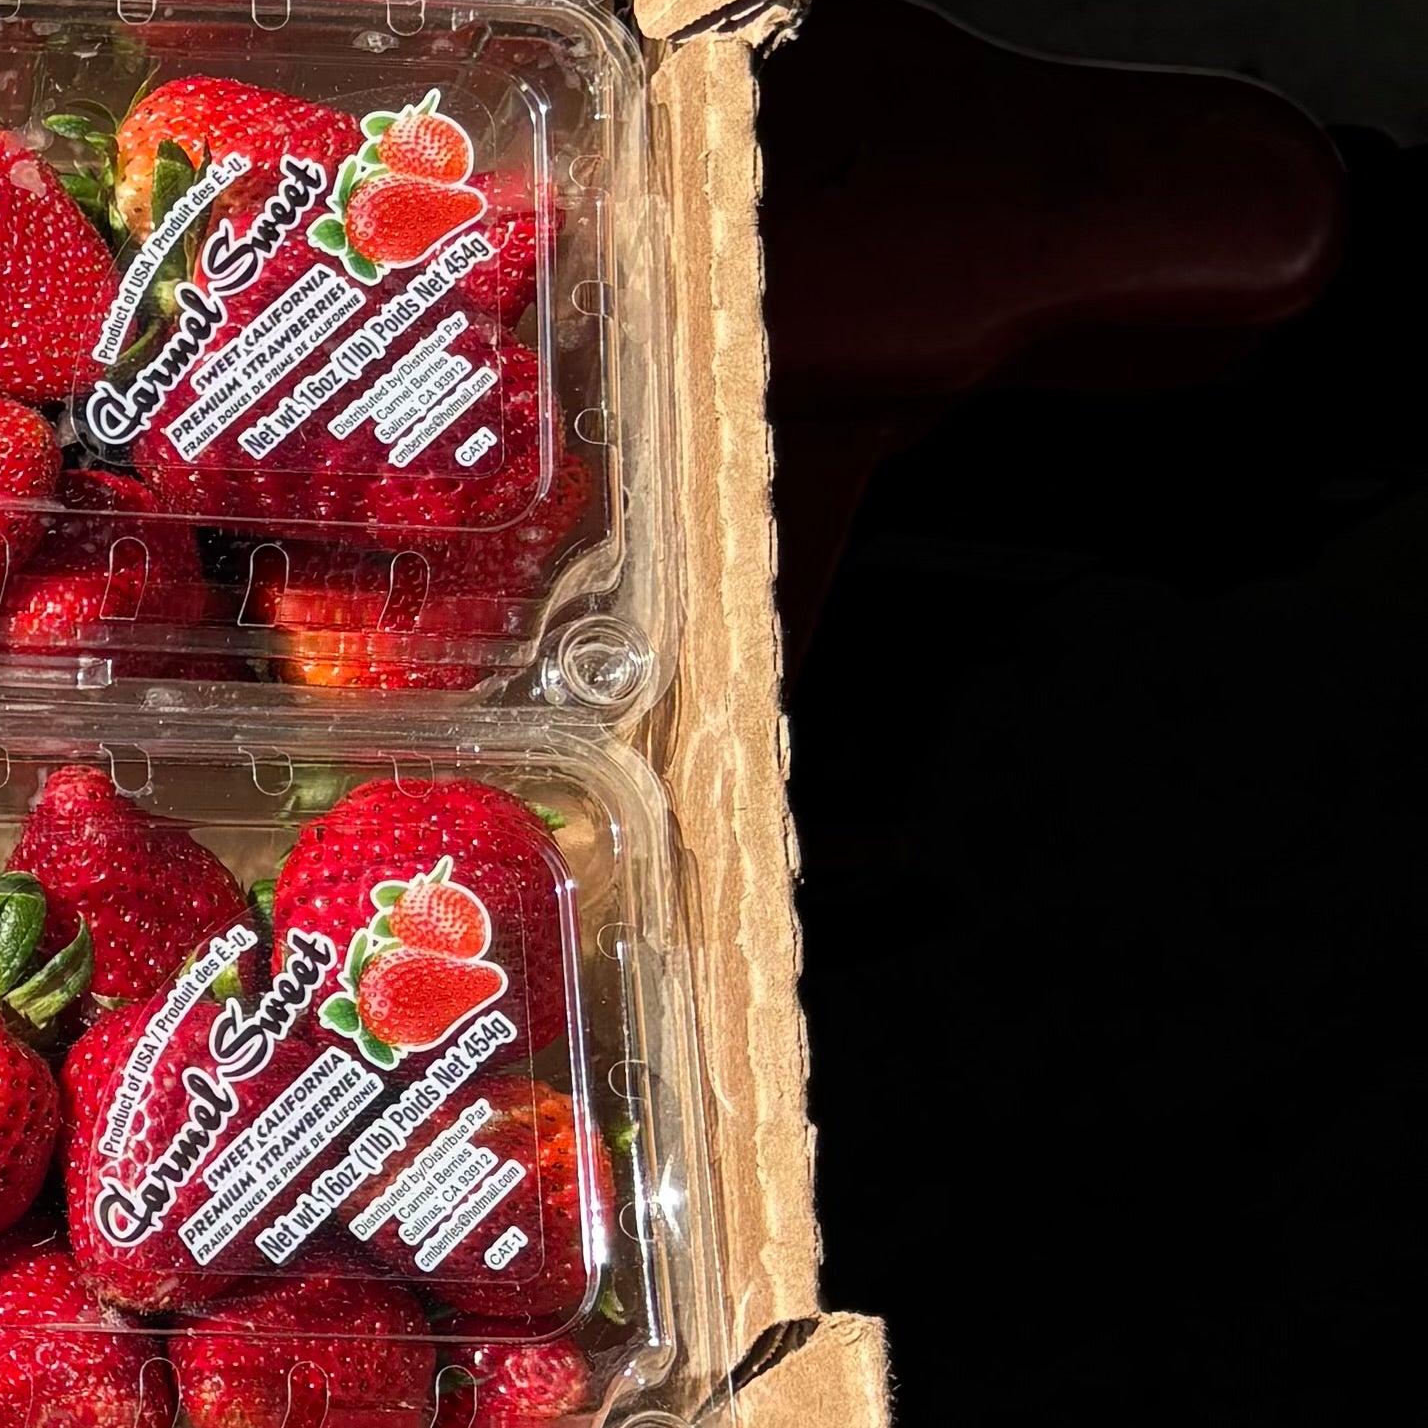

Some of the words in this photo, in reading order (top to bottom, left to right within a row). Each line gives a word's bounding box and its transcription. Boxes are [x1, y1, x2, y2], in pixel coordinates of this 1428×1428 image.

[92, 286, 224, 439] Carmel
[206, 160, 321, 291] Sweet
[170, 376, 243, 444] PREMIUM
[241, 281, 347, 381] STRAWBERRIES
[195, 343, 242, 392] SWEET
[244, 268, 332, 347] CALIFORNIA
[154, 980, 200, 1034] Produit
[194, 958, 220, 985] des
[100, 1072, 234, 1241] Carmel
[214, 933, 331, 1077] Sweet
[102, 1092, 135, 1154] Product
[127, 1072, 143, 1092] of
[133, 1042, 159, 1074] USA
[207, 1135, 255, 1188] SWEET
[256, 1052, 346, 1139] CALIFORNIA
[183, 1170, 258, 1246] PREMIUM
[255, 1066, 363, 1176] STRAWBERRIES
[260, 1222, 300, 1260] Net
[290, 1200, 326, 1231] wt.
[316, 1161, 363, 1204] 16oz
[353, 1124, 401, 1171] (1lb)
[387, 1084, 442, 1133] Poids
[431, 1052, 471, 1091] Net
[463, 1017, 512, 1060] 454g
